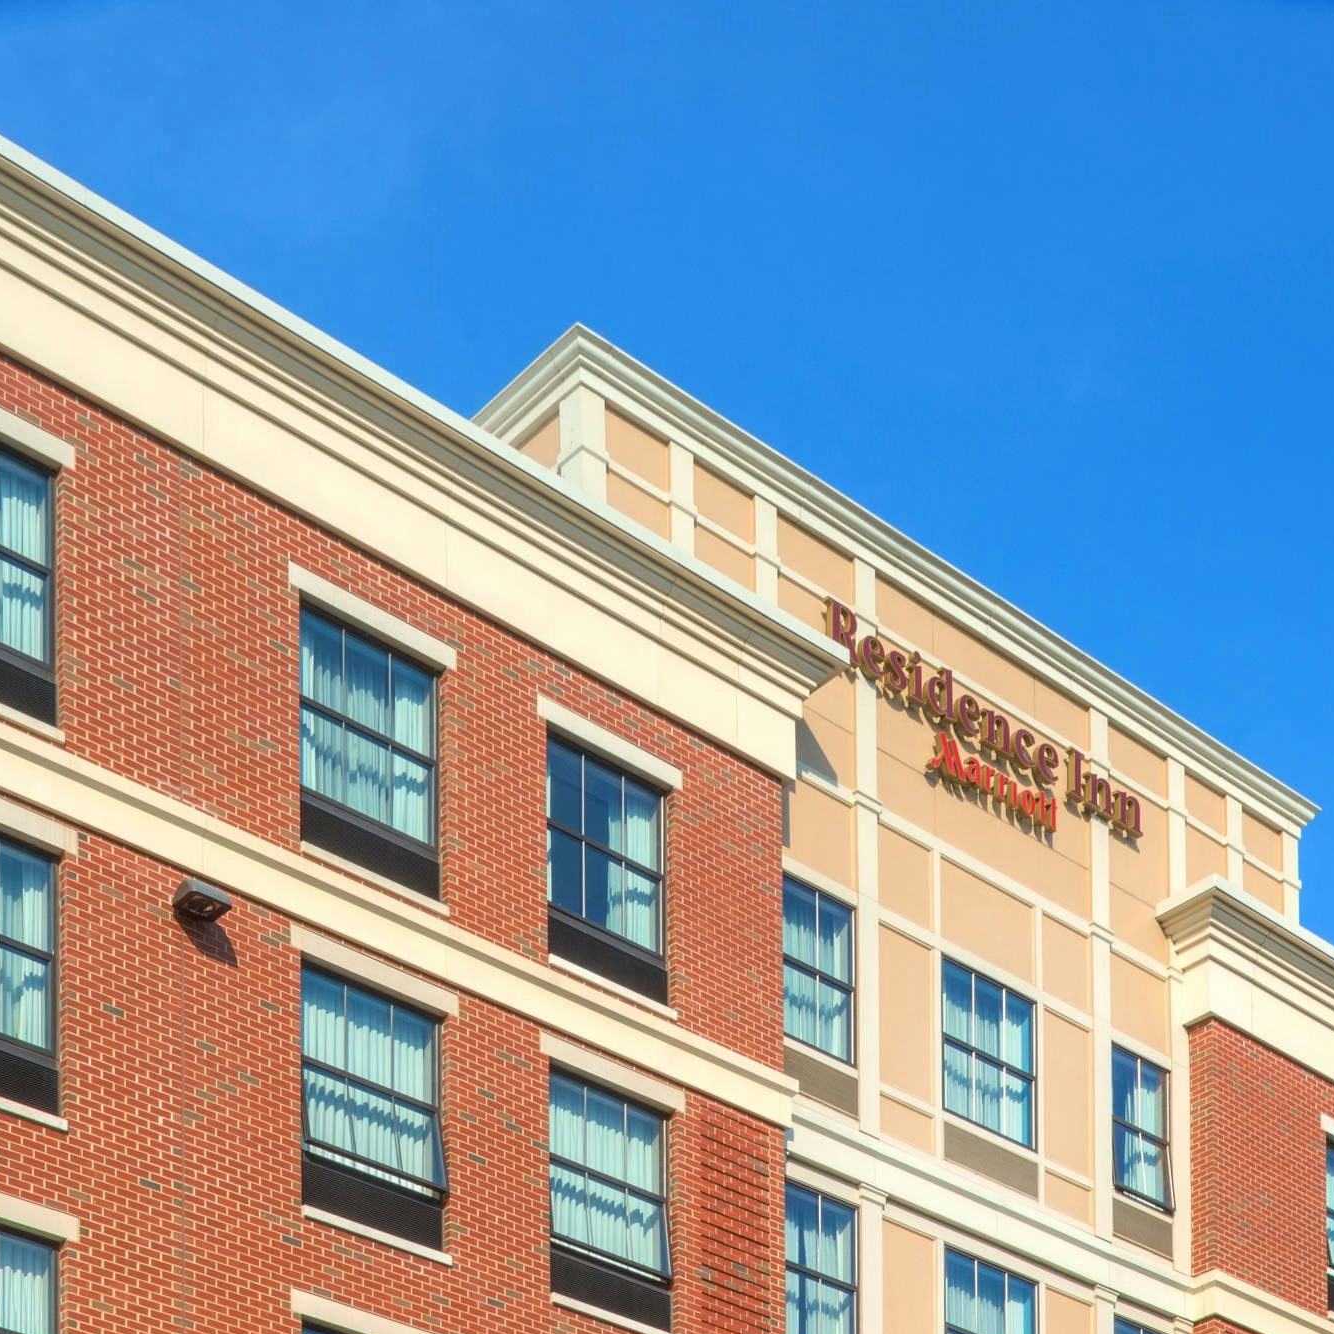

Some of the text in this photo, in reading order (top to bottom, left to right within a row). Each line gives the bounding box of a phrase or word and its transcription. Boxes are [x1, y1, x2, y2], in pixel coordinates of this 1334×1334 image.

[824, 595, 1143, 838] Residence Inn
[925, 731, 1057, 833] Marriott
